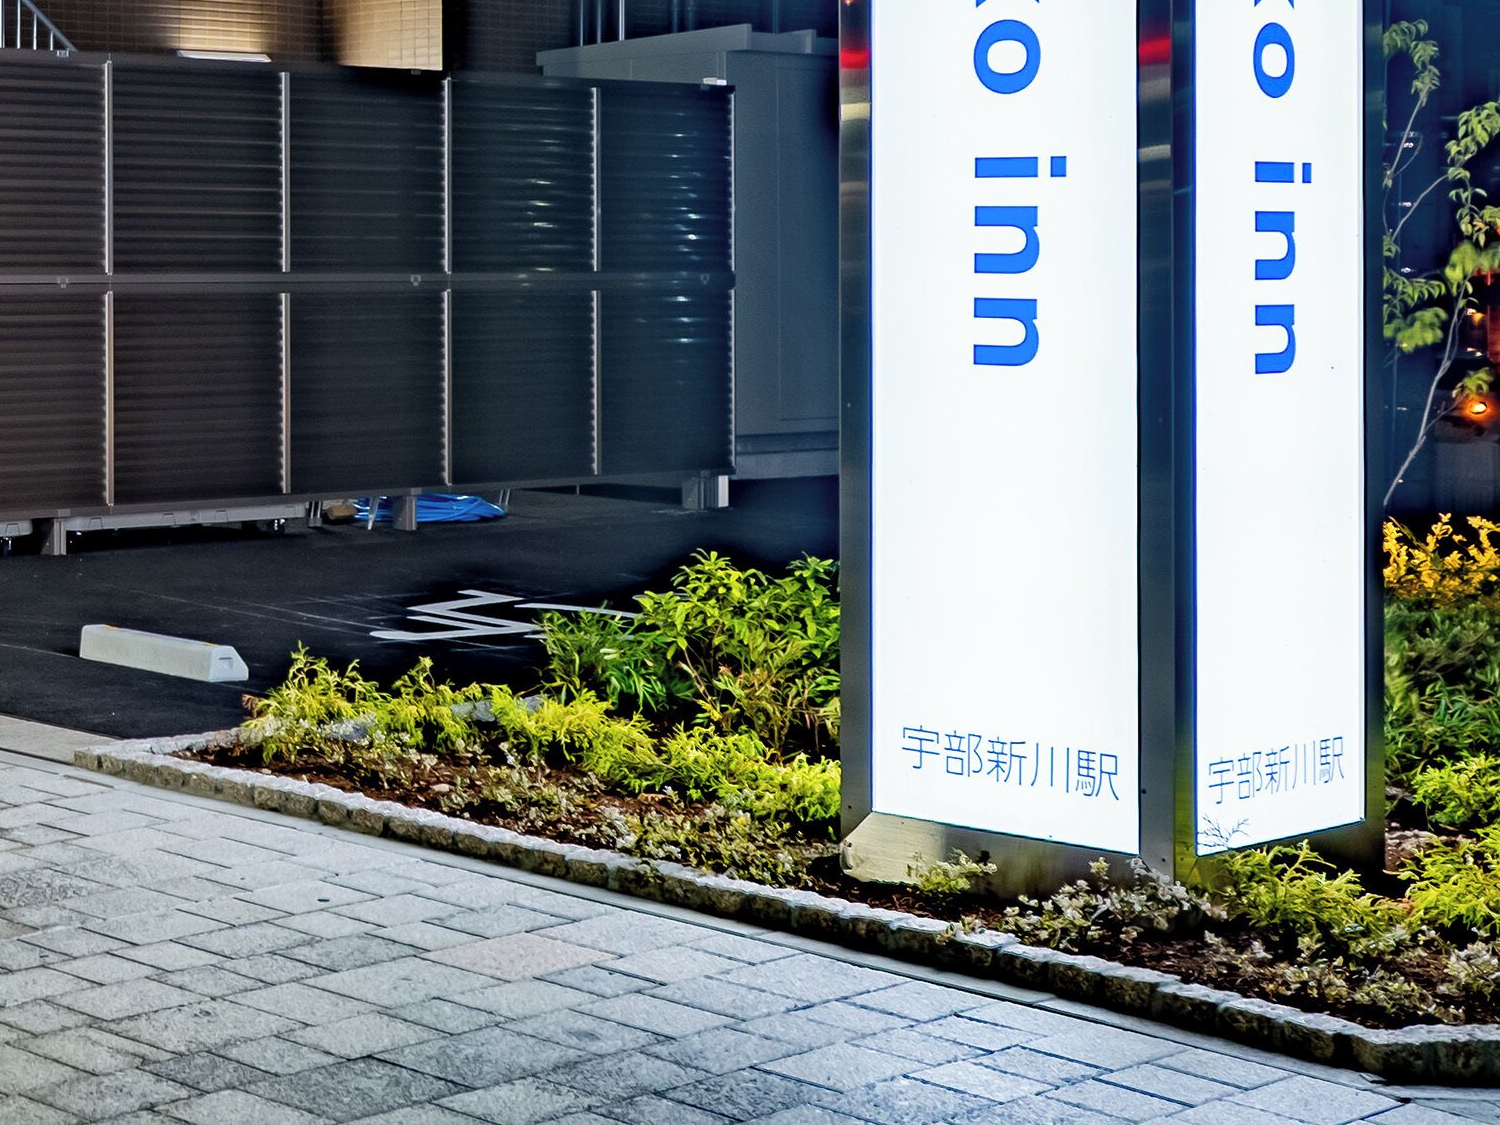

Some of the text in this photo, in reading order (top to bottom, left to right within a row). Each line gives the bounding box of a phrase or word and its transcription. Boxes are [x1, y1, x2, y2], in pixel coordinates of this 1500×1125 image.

[973, 155, 1067, 367] inn
[1254, 160, 1312, 375] inn
[901, 725, 1119, 801] 宇部新川駅
[1208, 736, 1345, 804] 宇部新川駅
